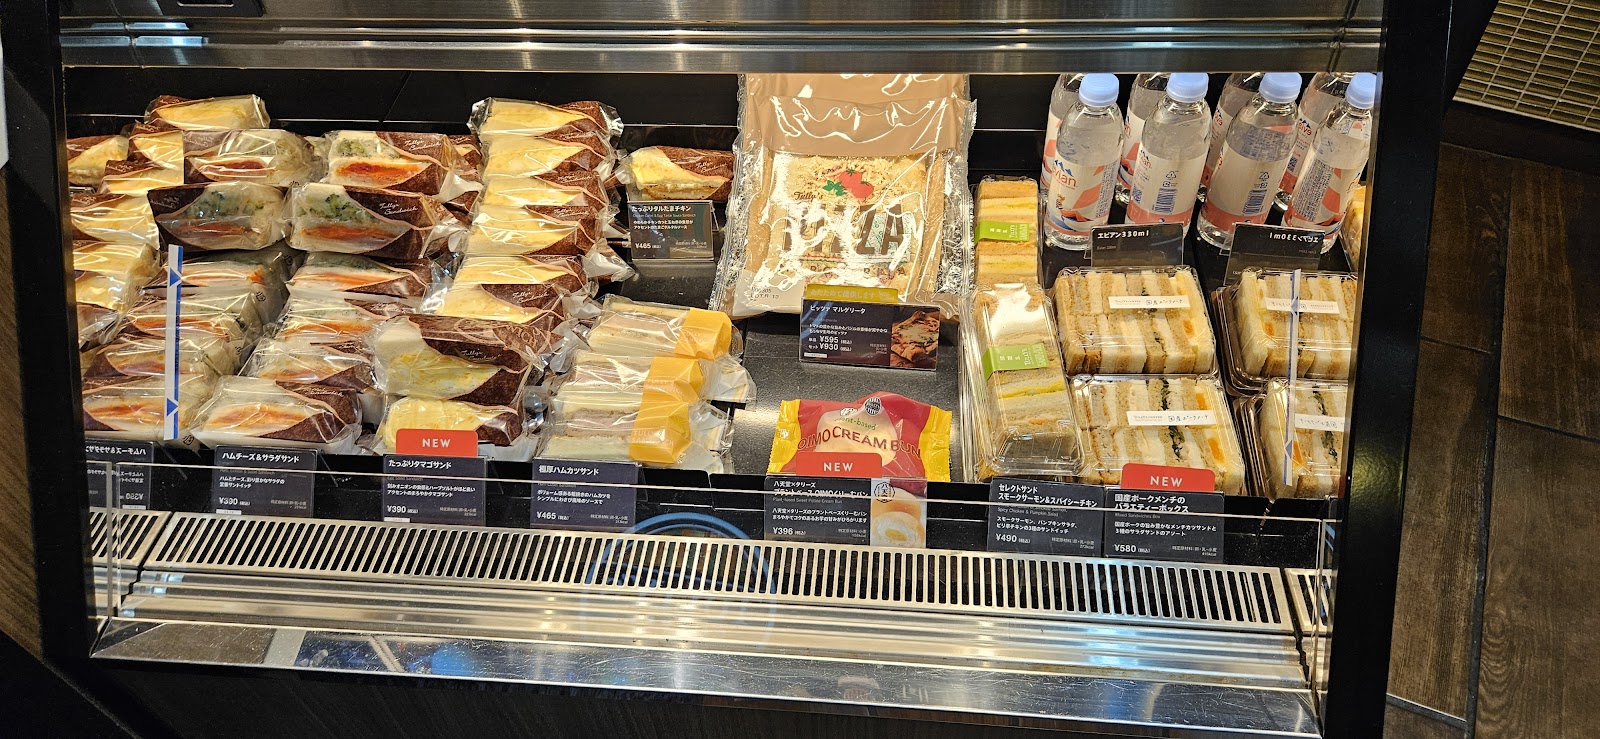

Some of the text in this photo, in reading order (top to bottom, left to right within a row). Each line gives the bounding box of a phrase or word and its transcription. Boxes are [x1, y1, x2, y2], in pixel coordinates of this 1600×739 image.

[379, 201, 399, 209] Tully's
[384, 205, 418, 215] Sandwich
[820, 336, 838, 344] ¥595
[820, 343, 838, 351] ¥930
[422, 438, 451, 448] NEW
[798, 426, 921, 459] OIMO CREAM BUN
[222, 452, 299, 463] ハムチーズ&サラダサンド
[388, 460, 452, 469] たっぷりタマゴサンド
[823, 462, 853, 472] NEW
[539, 465, 600, 475] 極厚ハムカツサンド
[1150, 476, 1182, 487] NEW
[999, 484, 1038, 494] セレクトサンド
[219, 497, 238, 505] ¥390
[998, 493, 1098, 507] スモークサーモン&スパイシーチキン
[1115, 494, 1185, 504] 国産ポークメンチの
[387, 505, 406, 513] ¥390
[1115, 503, 1189, 513] バラエティーボックス
[537, 511, 556, 520] ¥465
[773, 527, 793, 535] ¥396
[996, 533, 1017, 543] ¥490
[1114, 544, 1136, 553] ¥580
